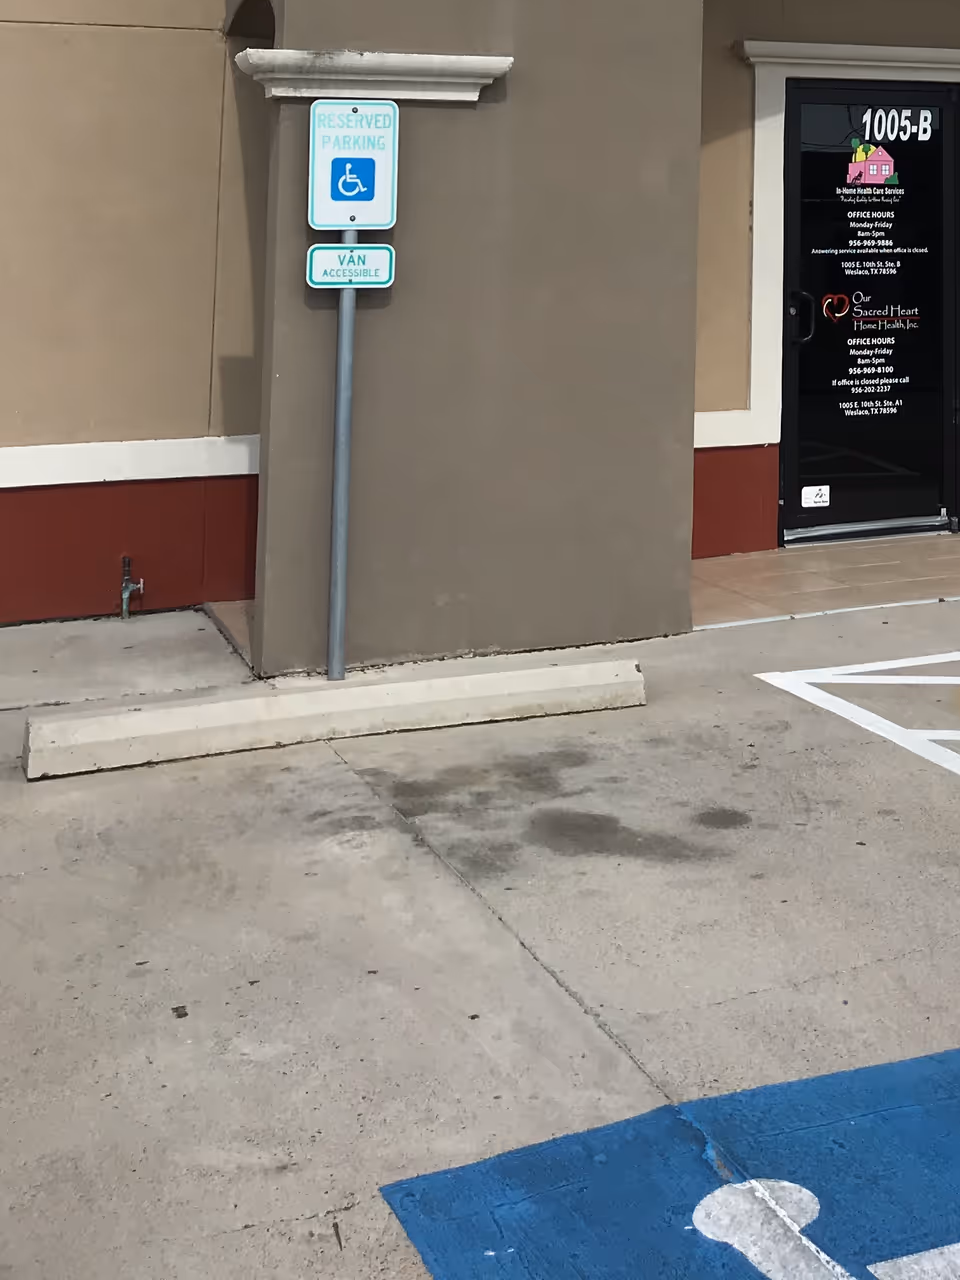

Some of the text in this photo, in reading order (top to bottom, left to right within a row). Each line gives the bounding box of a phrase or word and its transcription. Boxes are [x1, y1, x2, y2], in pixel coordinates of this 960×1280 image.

[317, 113, 392, 129] RESERVED
[862, 108, 932, 141] 1005-B
[321, 135, 385, 151] PARKING
[850, 221, 892, 229] Monday-Friday
[857, 230, 885, 238] 8am-5pm
[337, 254, 366, 266] VAN
[322, 268, 380, 277] ACCESSIBLE
[852, 291, 871, 304] Our
[852, 304, 918, 317] Sacred Heart
[854, 319, 919, 330] Home Health, Inc.
[849, 348, 893, 356] Monday-Friday
[857, 357, 885, 365] 8am-5pm
[849, 366, 894, 374] 956-969-8100
[880, 377, 898, 385] please
[851, 385, 891, 393] 956-202-2237
